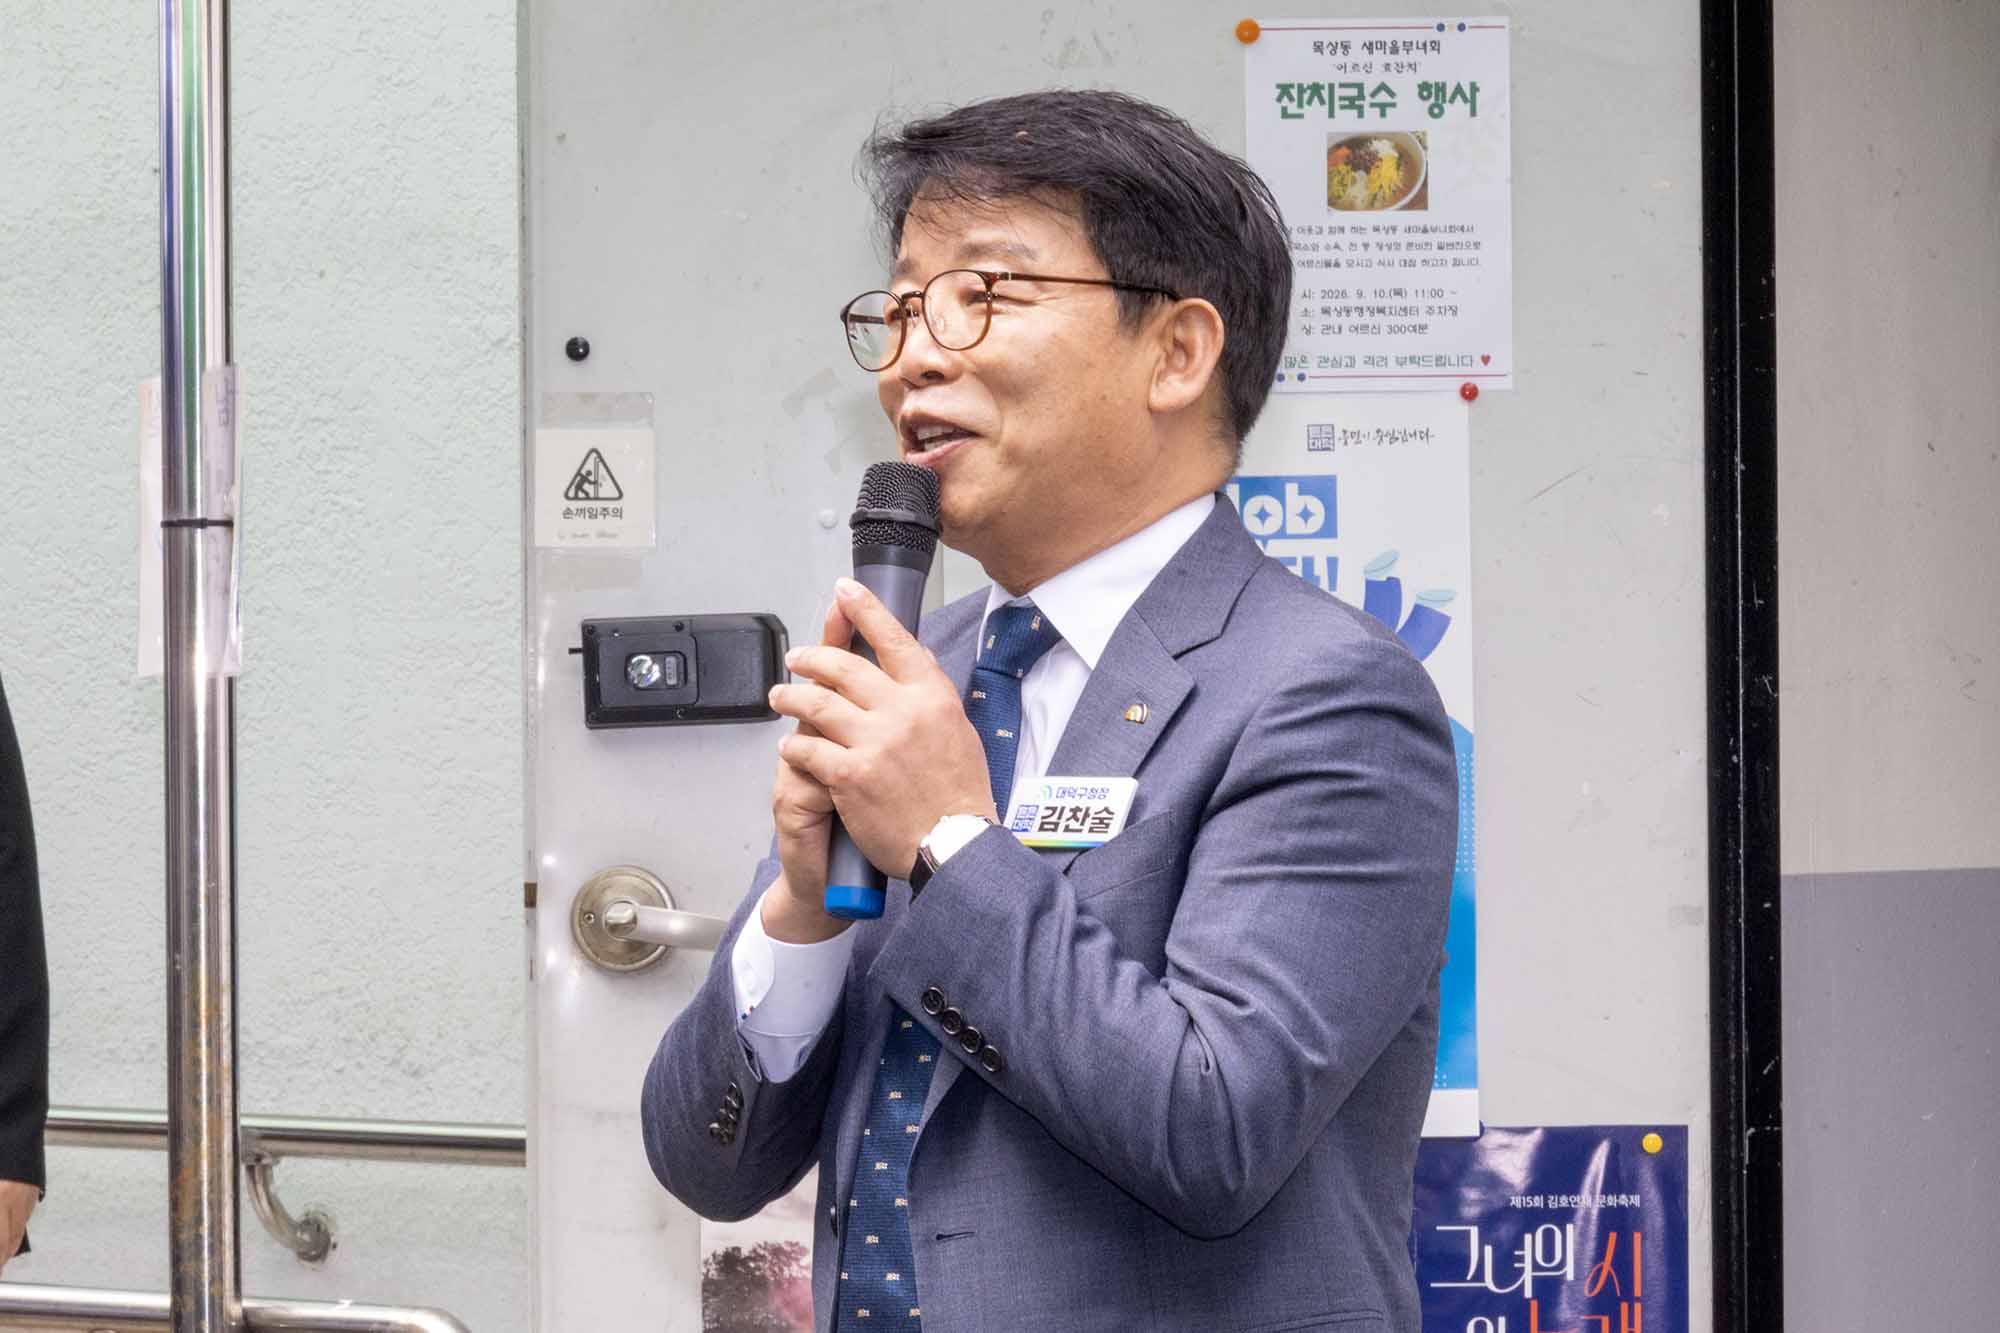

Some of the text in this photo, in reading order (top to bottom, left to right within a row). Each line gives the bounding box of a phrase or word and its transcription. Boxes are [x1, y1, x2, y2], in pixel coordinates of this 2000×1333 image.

[1312, 40, 1441, 56] 목상동 새마을부녀회
[1275, 80, 1480, 119] 잔치국수 행사
[1415, 288, 1444, 299] 11:00
[1425, 305, 1458, 317] 주차장
[1321, 324, 1343, 335] 관내
[1348, 323, 1381, 336] 어르신
[1316, 355, 1356, 369] 관심과
[1363, 354, 1389, 368] 격려
[1394, 354, 1474, 368] 부탁드립니다
[562, 506, 623, 521] 손끼임주의
[1055, 786, 1110, 800] 대덕구청장
[1037, 805, 1116, 834] 김찬술
[1510, 1194, 1544, 1209] 제15회
[1598, 1194, 1641, 1209] 문화축제
[1430, 1223, 1643, 1299] 그녀의 시
